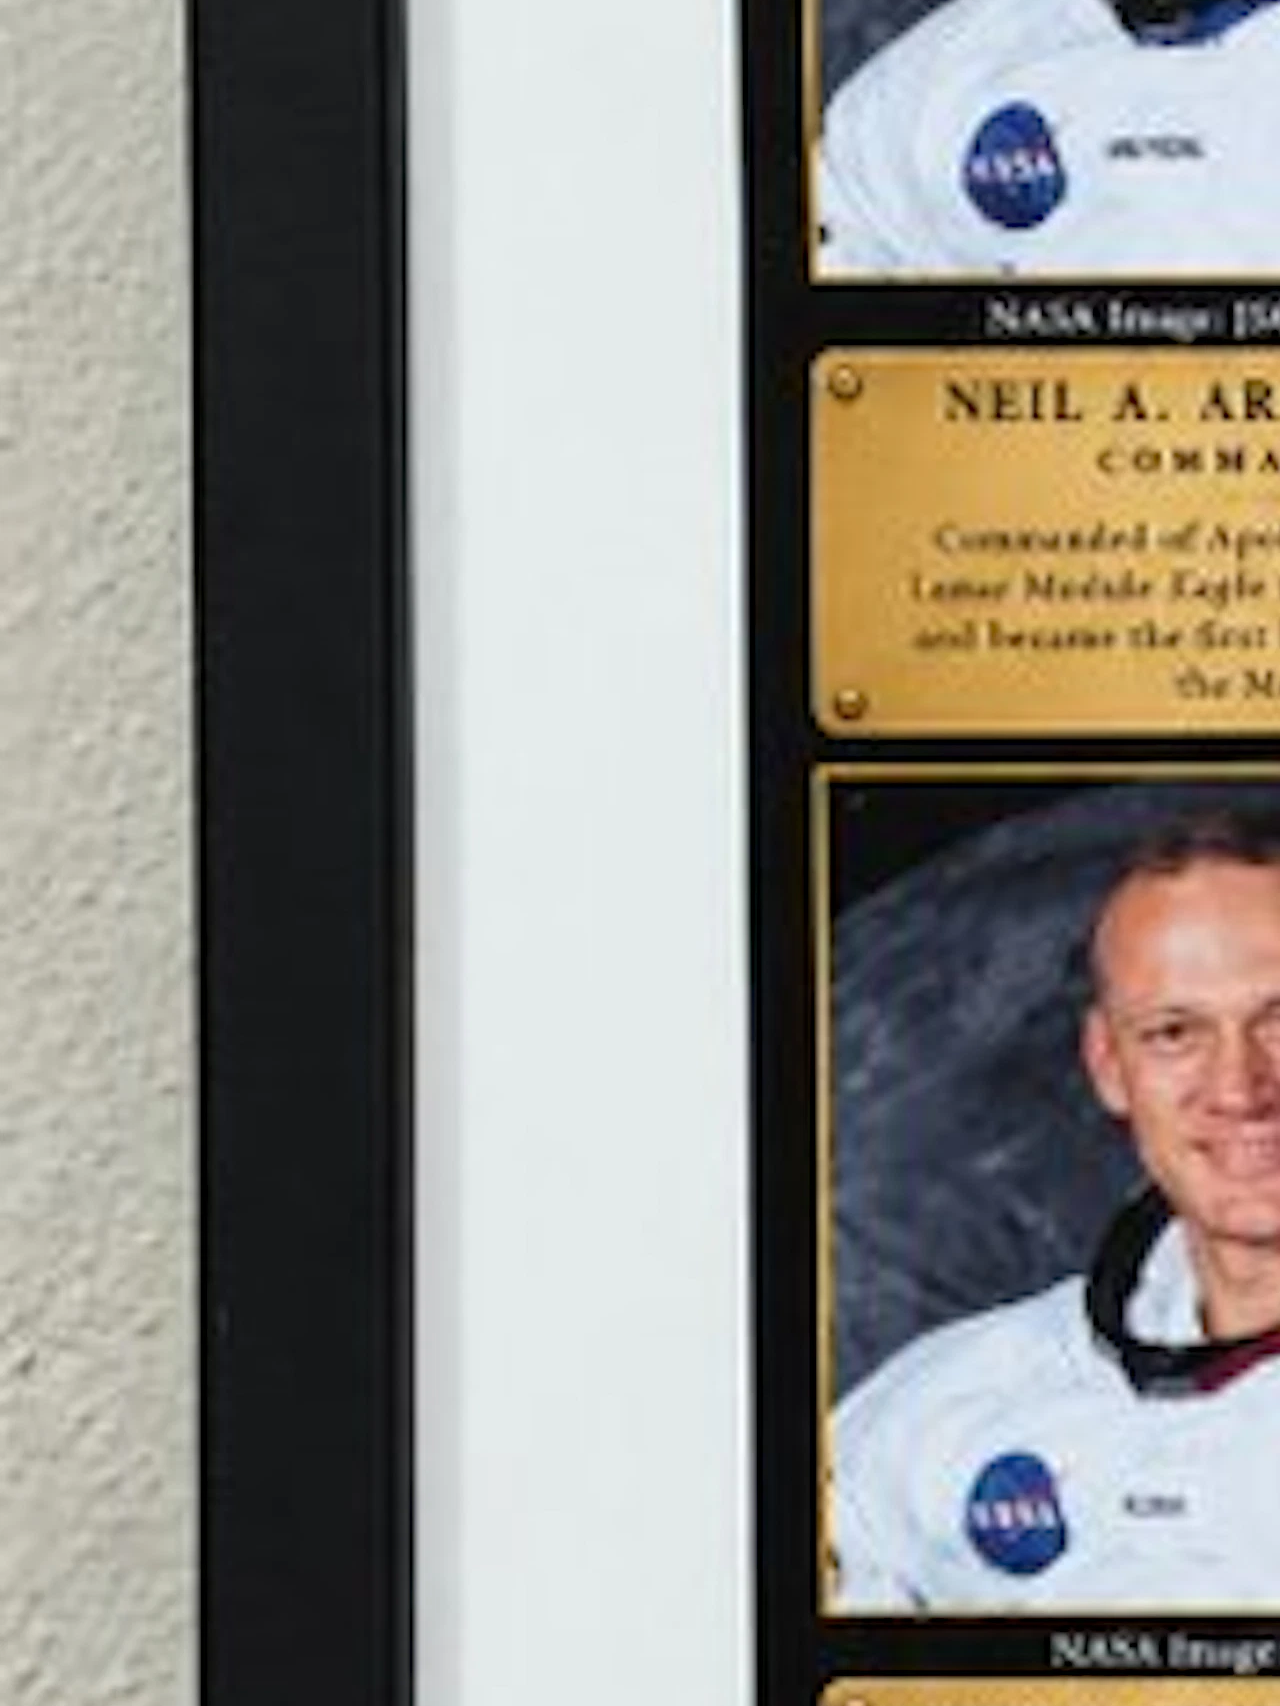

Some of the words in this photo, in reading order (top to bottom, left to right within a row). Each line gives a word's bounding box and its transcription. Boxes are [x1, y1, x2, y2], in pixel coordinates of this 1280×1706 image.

[983, 298, 1095, 338] NASA
[945, 380, 1082, 421] NEIL
[1111, 378, 1170, 421] A.
[1158, 521, 1200, 555] of
[909, 569, 1008, 603] Lunar
[1022, 569, 1153, 603] Module
[1168, 569, 1268, 613] Eagle
[910, 618, 982, 653] and
[988, 618, 1116, 653] became
[1126, 618, 1184, 653] the
[1192, 618, 1272, 653] first
[1174, 667, 1234, 703] the
[1050, 1631, 1161, 1667] NASA
